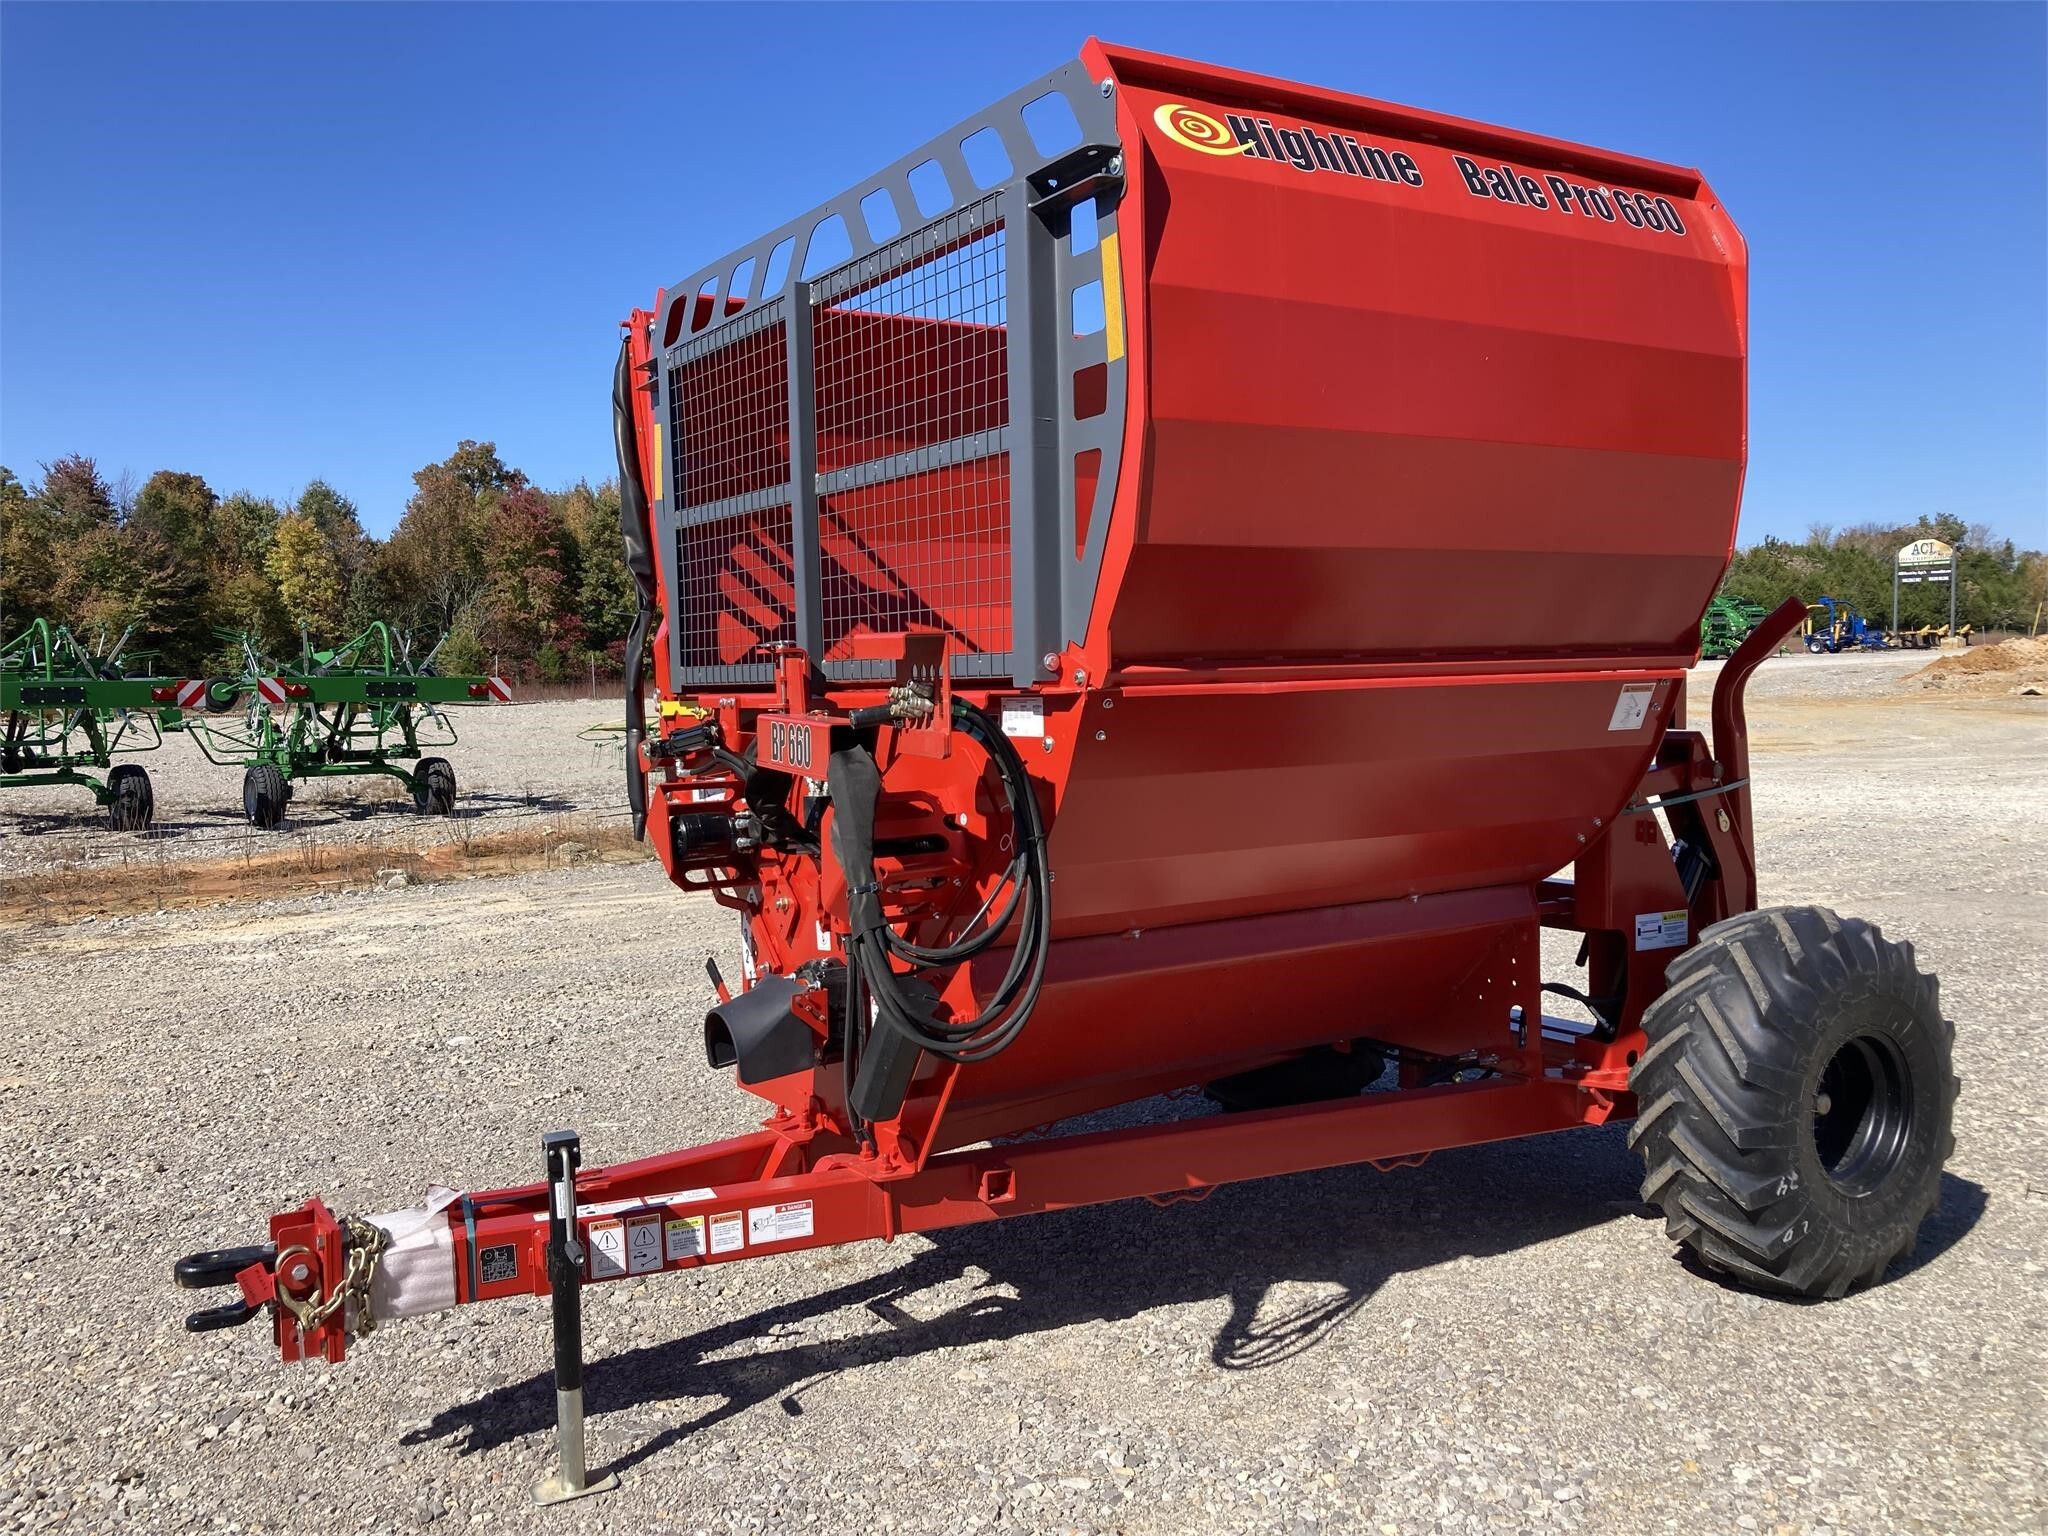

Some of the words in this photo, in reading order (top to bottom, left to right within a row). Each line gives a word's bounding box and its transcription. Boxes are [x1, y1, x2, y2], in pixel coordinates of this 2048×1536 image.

[1224, 113, 1423, 187] Highline
[1452, 154, 1549, 210] Bale
[1612, 189, 1687, 235] 660
[1911, 542, 1937, 555] ACL
[770, 721, 787, 763] BP
[788, 723, 811, 769] 660
[787, 1203, 807, 1211] DANGER
[599, 1222, 619, 1230] WARNING
[677, 1220, 698, 1228] CAUTION
